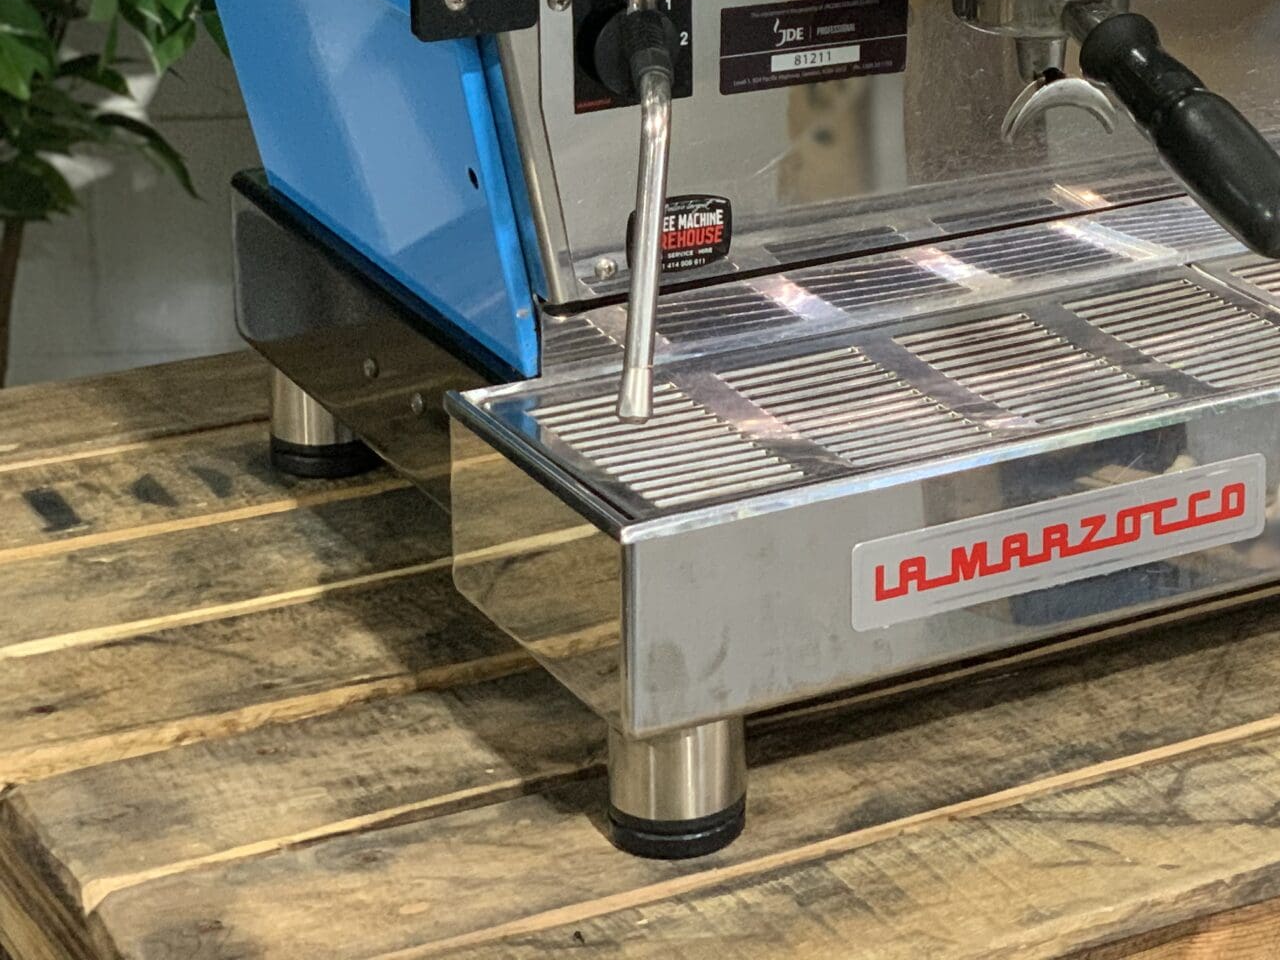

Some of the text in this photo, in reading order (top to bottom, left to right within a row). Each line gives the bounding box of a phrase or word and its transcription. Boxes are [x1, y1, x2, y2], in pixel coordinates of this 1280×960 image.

[679, 31, 689, 47] 2
[775, 26, 804, 48] JDE
[794, 50, 832, 66] 81211
[662, 208, 724, 233] EE MACHINE
[661, 224, 724, 250] REHOUSE
[874, 481, 1246, 603] LA MARZOCCO
